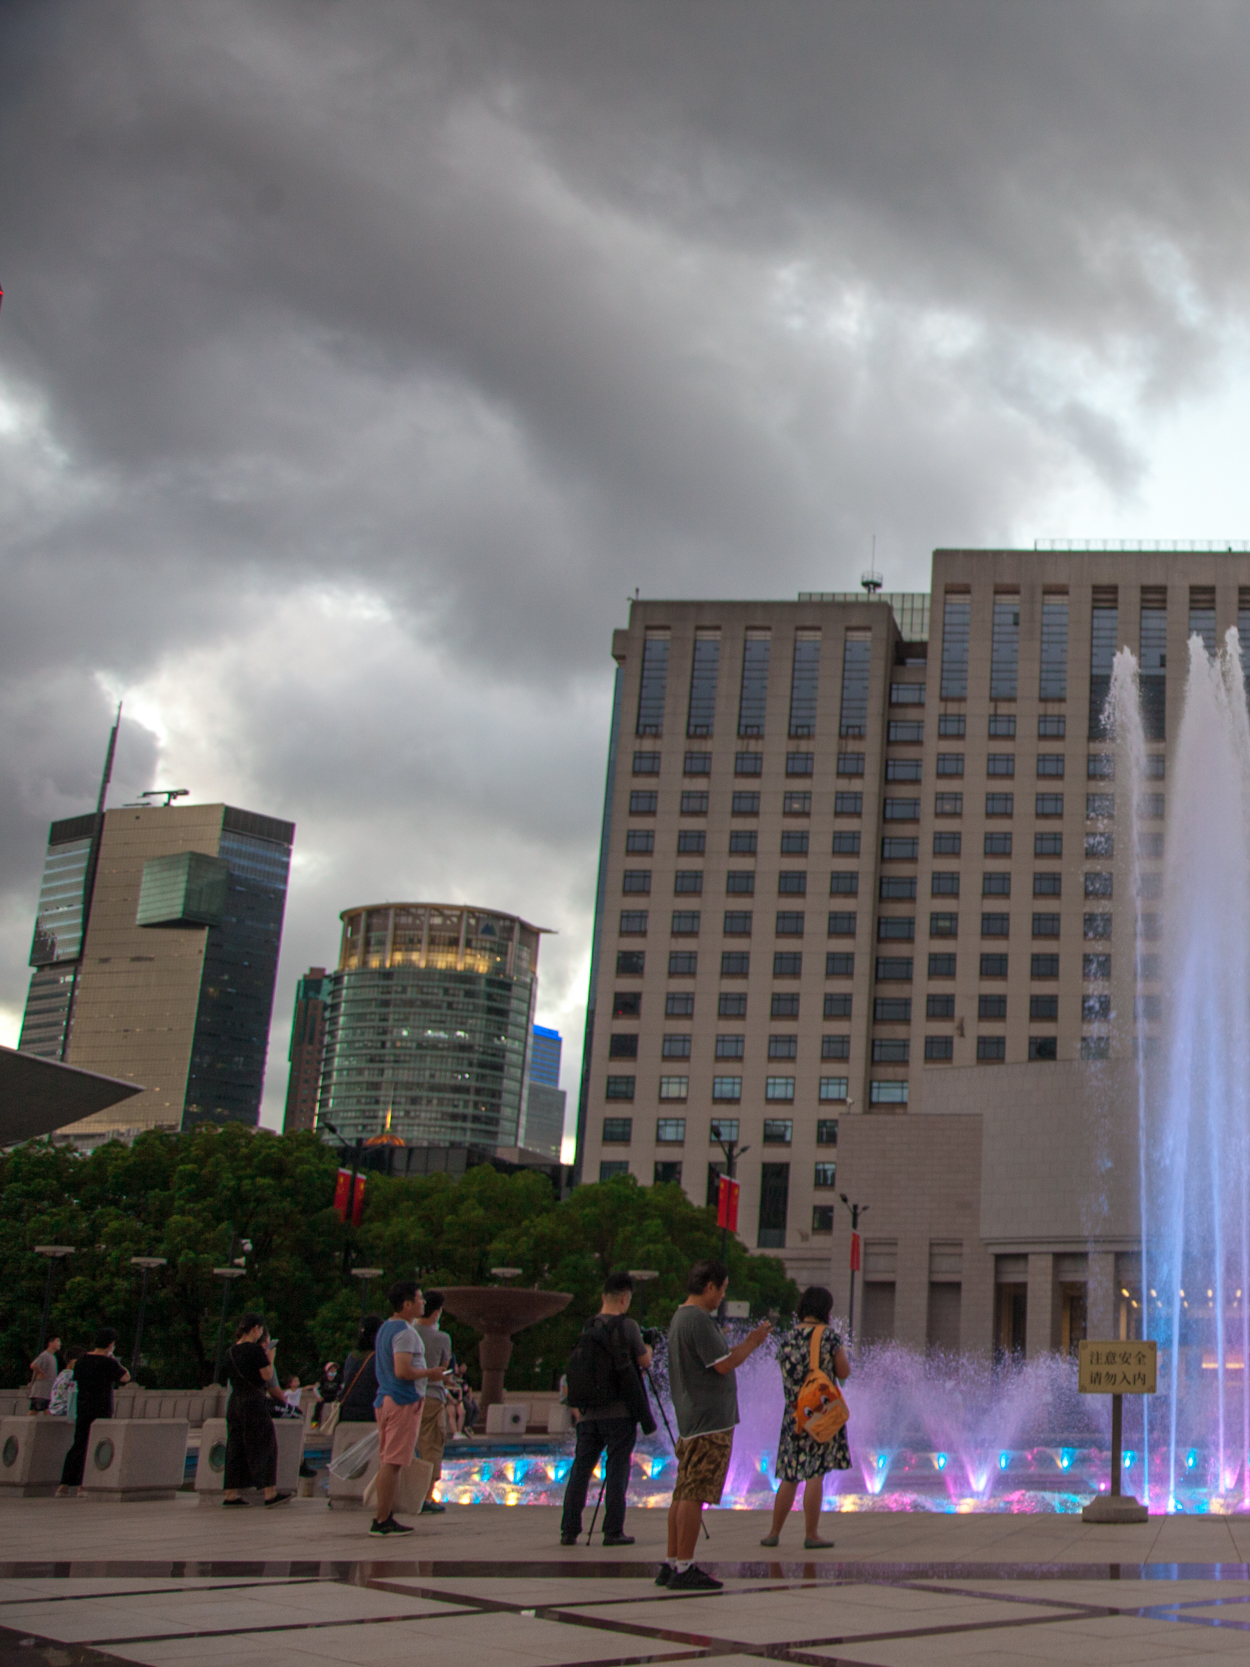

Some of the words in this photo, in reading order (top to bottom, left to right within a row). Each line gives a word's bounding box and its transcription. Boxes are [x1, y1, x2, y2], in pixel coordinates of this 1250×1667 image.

[1089, 1350, 1147, 1366] 注意安全
[1089, 1370, 1147, 1386] 请勿入内
